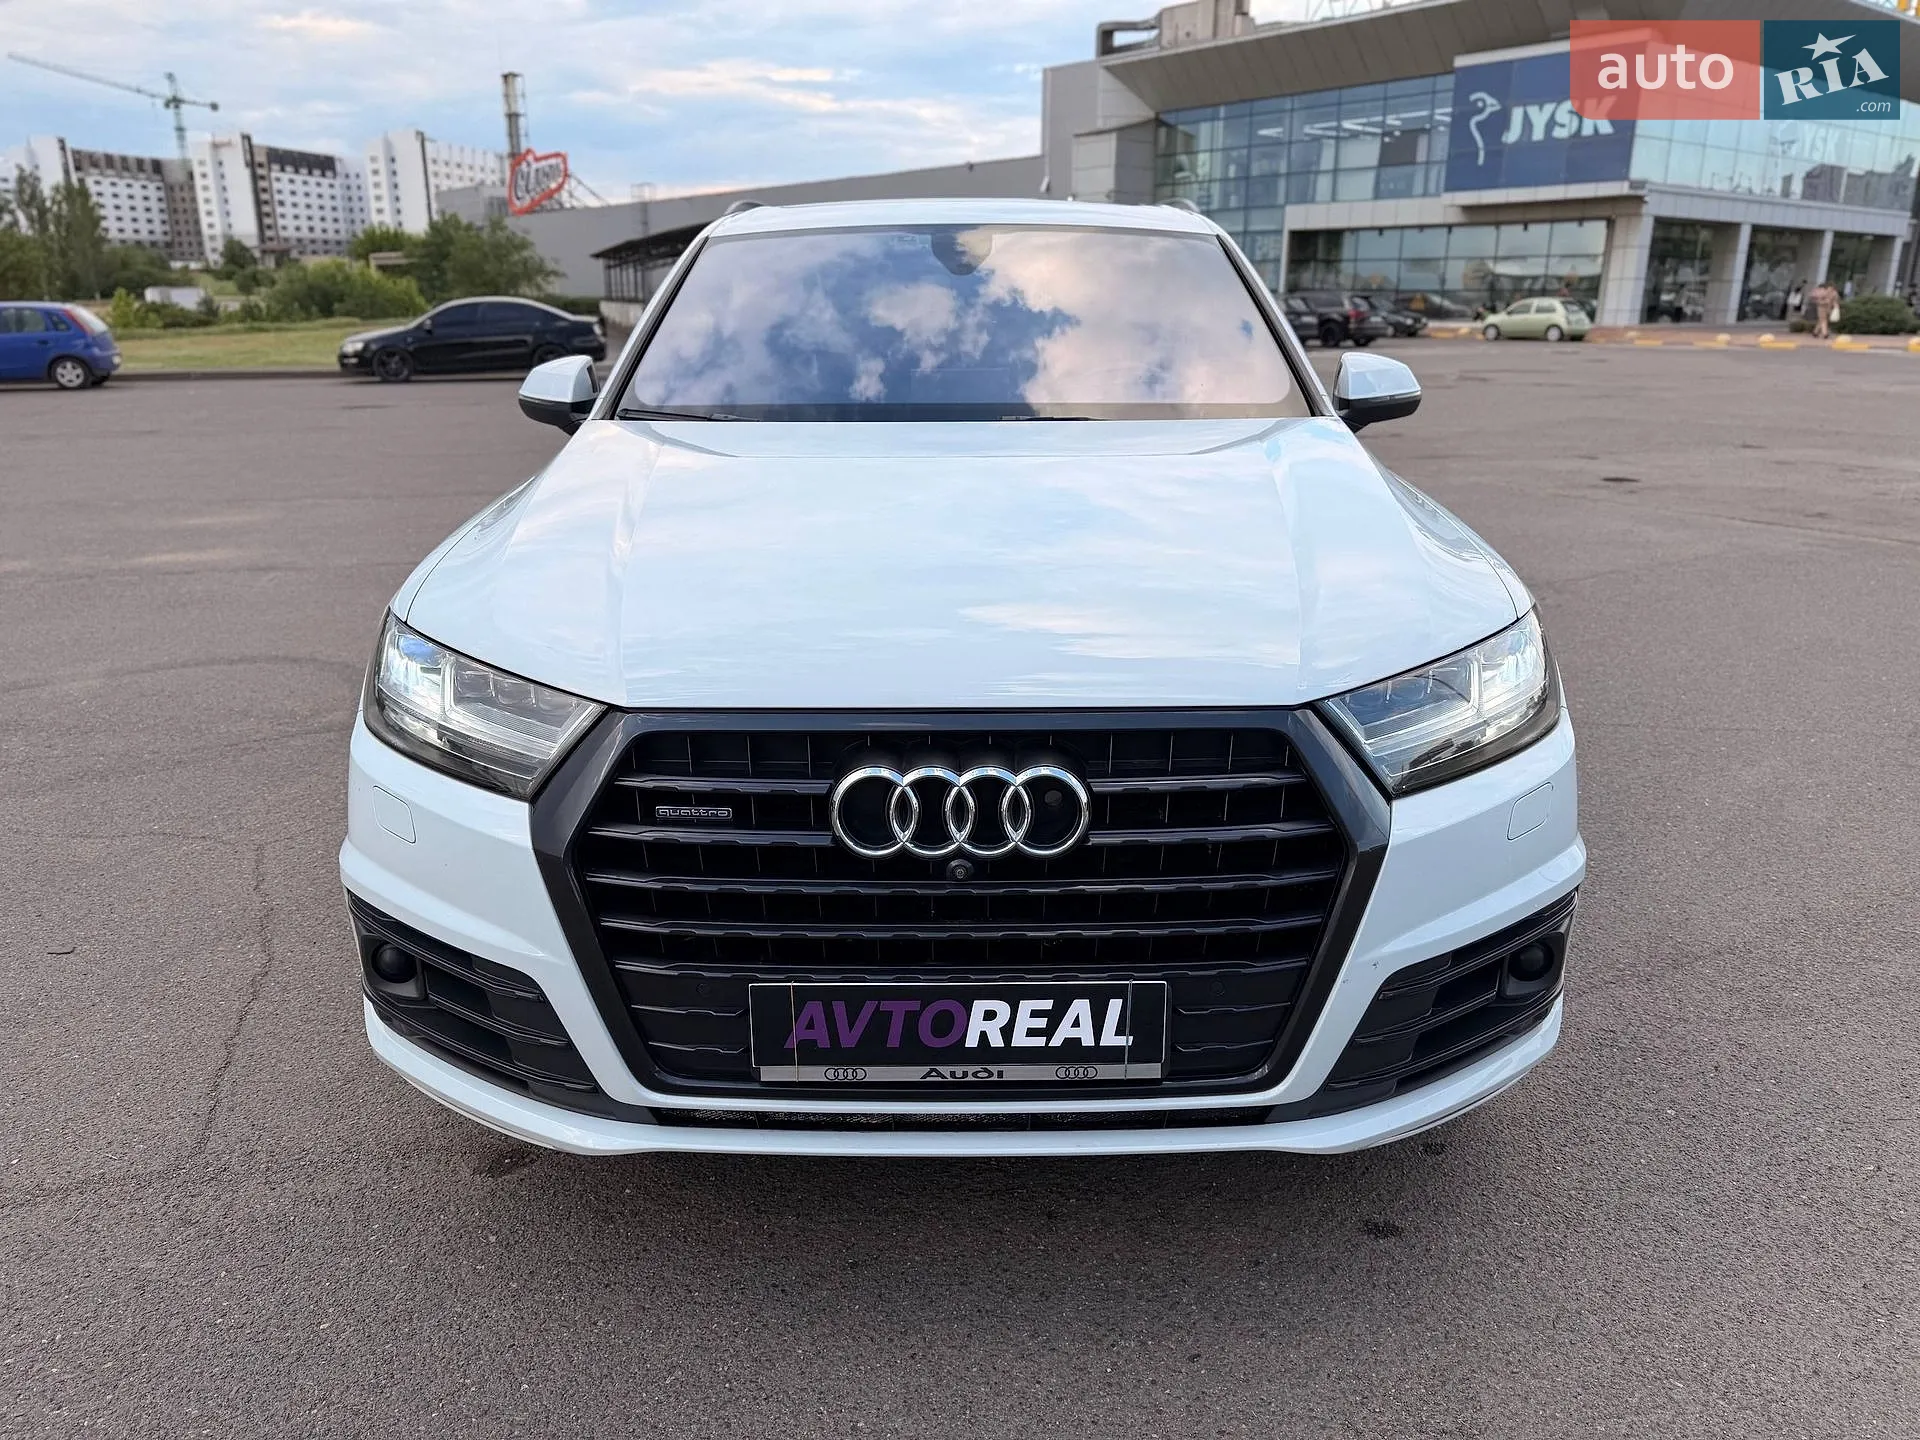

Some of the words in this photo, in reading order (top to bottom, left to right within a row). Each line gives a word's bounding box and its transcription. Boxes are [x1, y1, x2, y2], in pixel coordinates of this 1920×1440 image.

[1501, 96, 1616, 144] JYSK
[659, 809, 728, 817] quattro
[784, 999, 1134, 1048] AVTOREAL
[920, 1067, 1004, 1080] Audi
